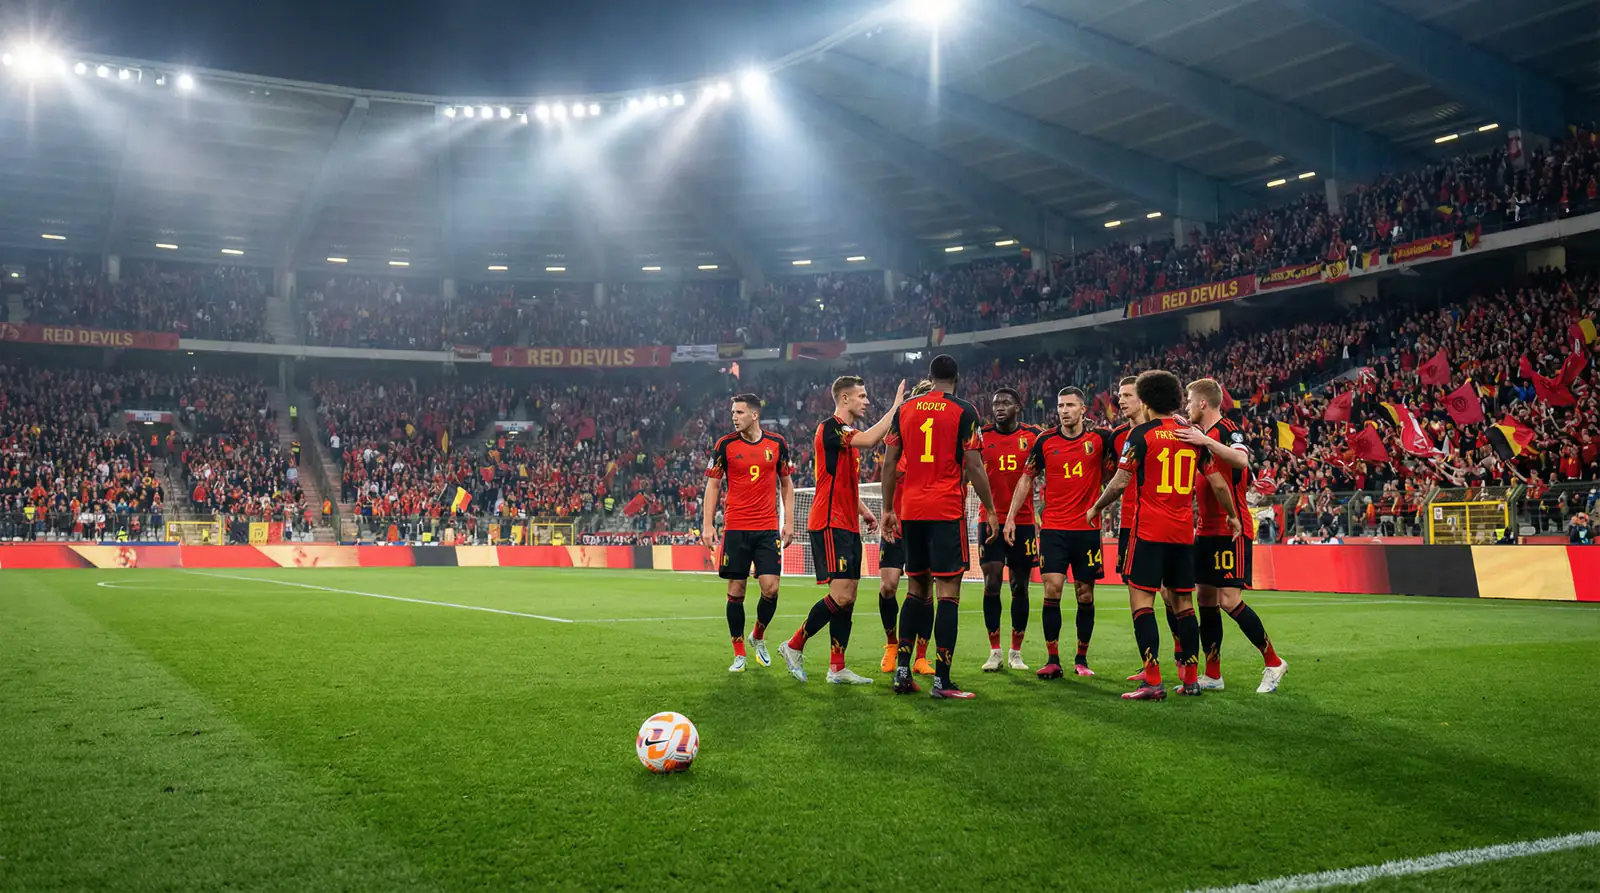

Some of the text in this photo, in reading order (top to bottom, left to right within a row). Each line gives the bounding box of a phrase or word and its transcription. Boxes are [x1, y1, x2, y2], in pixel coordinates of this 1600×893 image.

[1162, 280, 1239, 311] RED DEVILS
[43, 327, 134, 346] RED DEVILS
[527, 348, 636, 366] RED DEVILS
[919, 417, 935, 463] 1
[998, 454, 1017, 471] 15
[1064, 461, 1083, 479] 14
[1156, 447, 1197, 495] 10
[749, 465, 760, 482] 9
[1086, 548, 1103, 567] 14
[1214, 550, 1234, 570] 10
